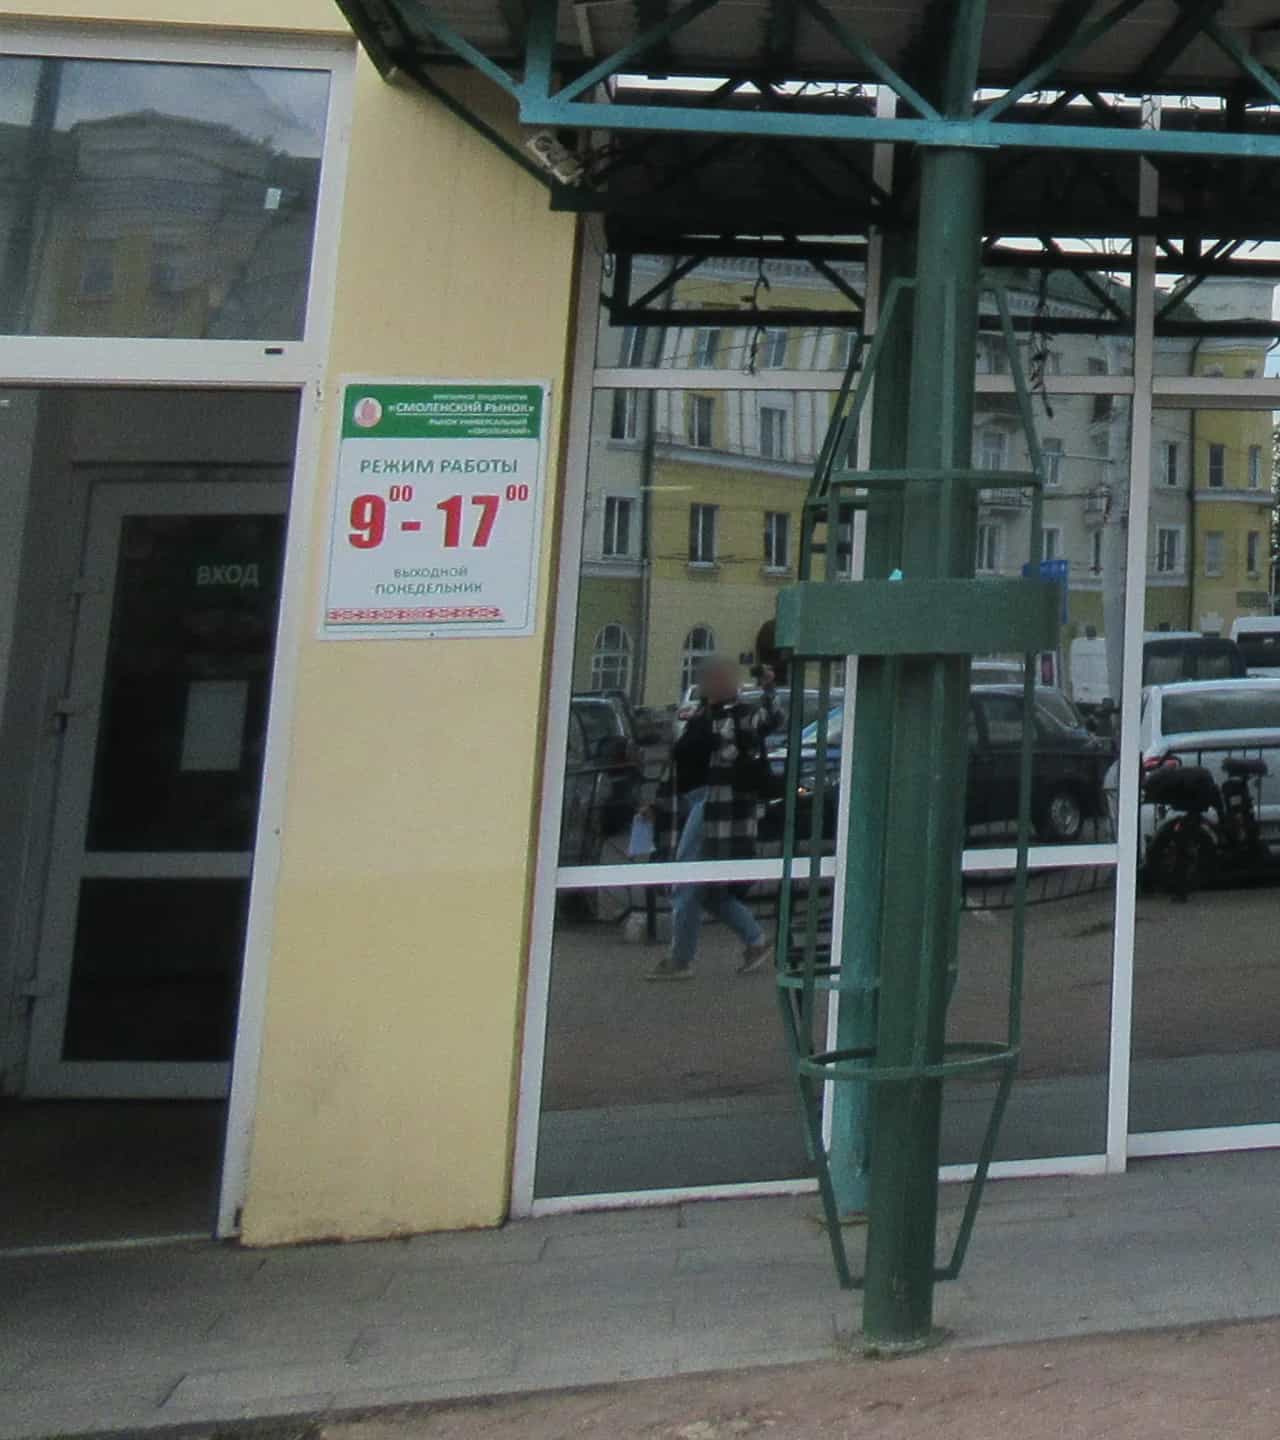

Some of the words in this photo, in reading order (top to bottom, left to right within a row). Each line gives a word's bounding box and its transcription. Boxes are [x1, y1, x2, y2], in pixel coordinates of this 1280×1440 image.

[359, 459, 434, 474] РЕЖИМ
[440, 459, 518, 474] РАБОТЫ
[196, 563, 260, 589] ВХОД
[394, 565, 468, 578] ВЫХОДНОЙ
[375, 582, 482, 596] ПОНЕДЕЛЬНИК
